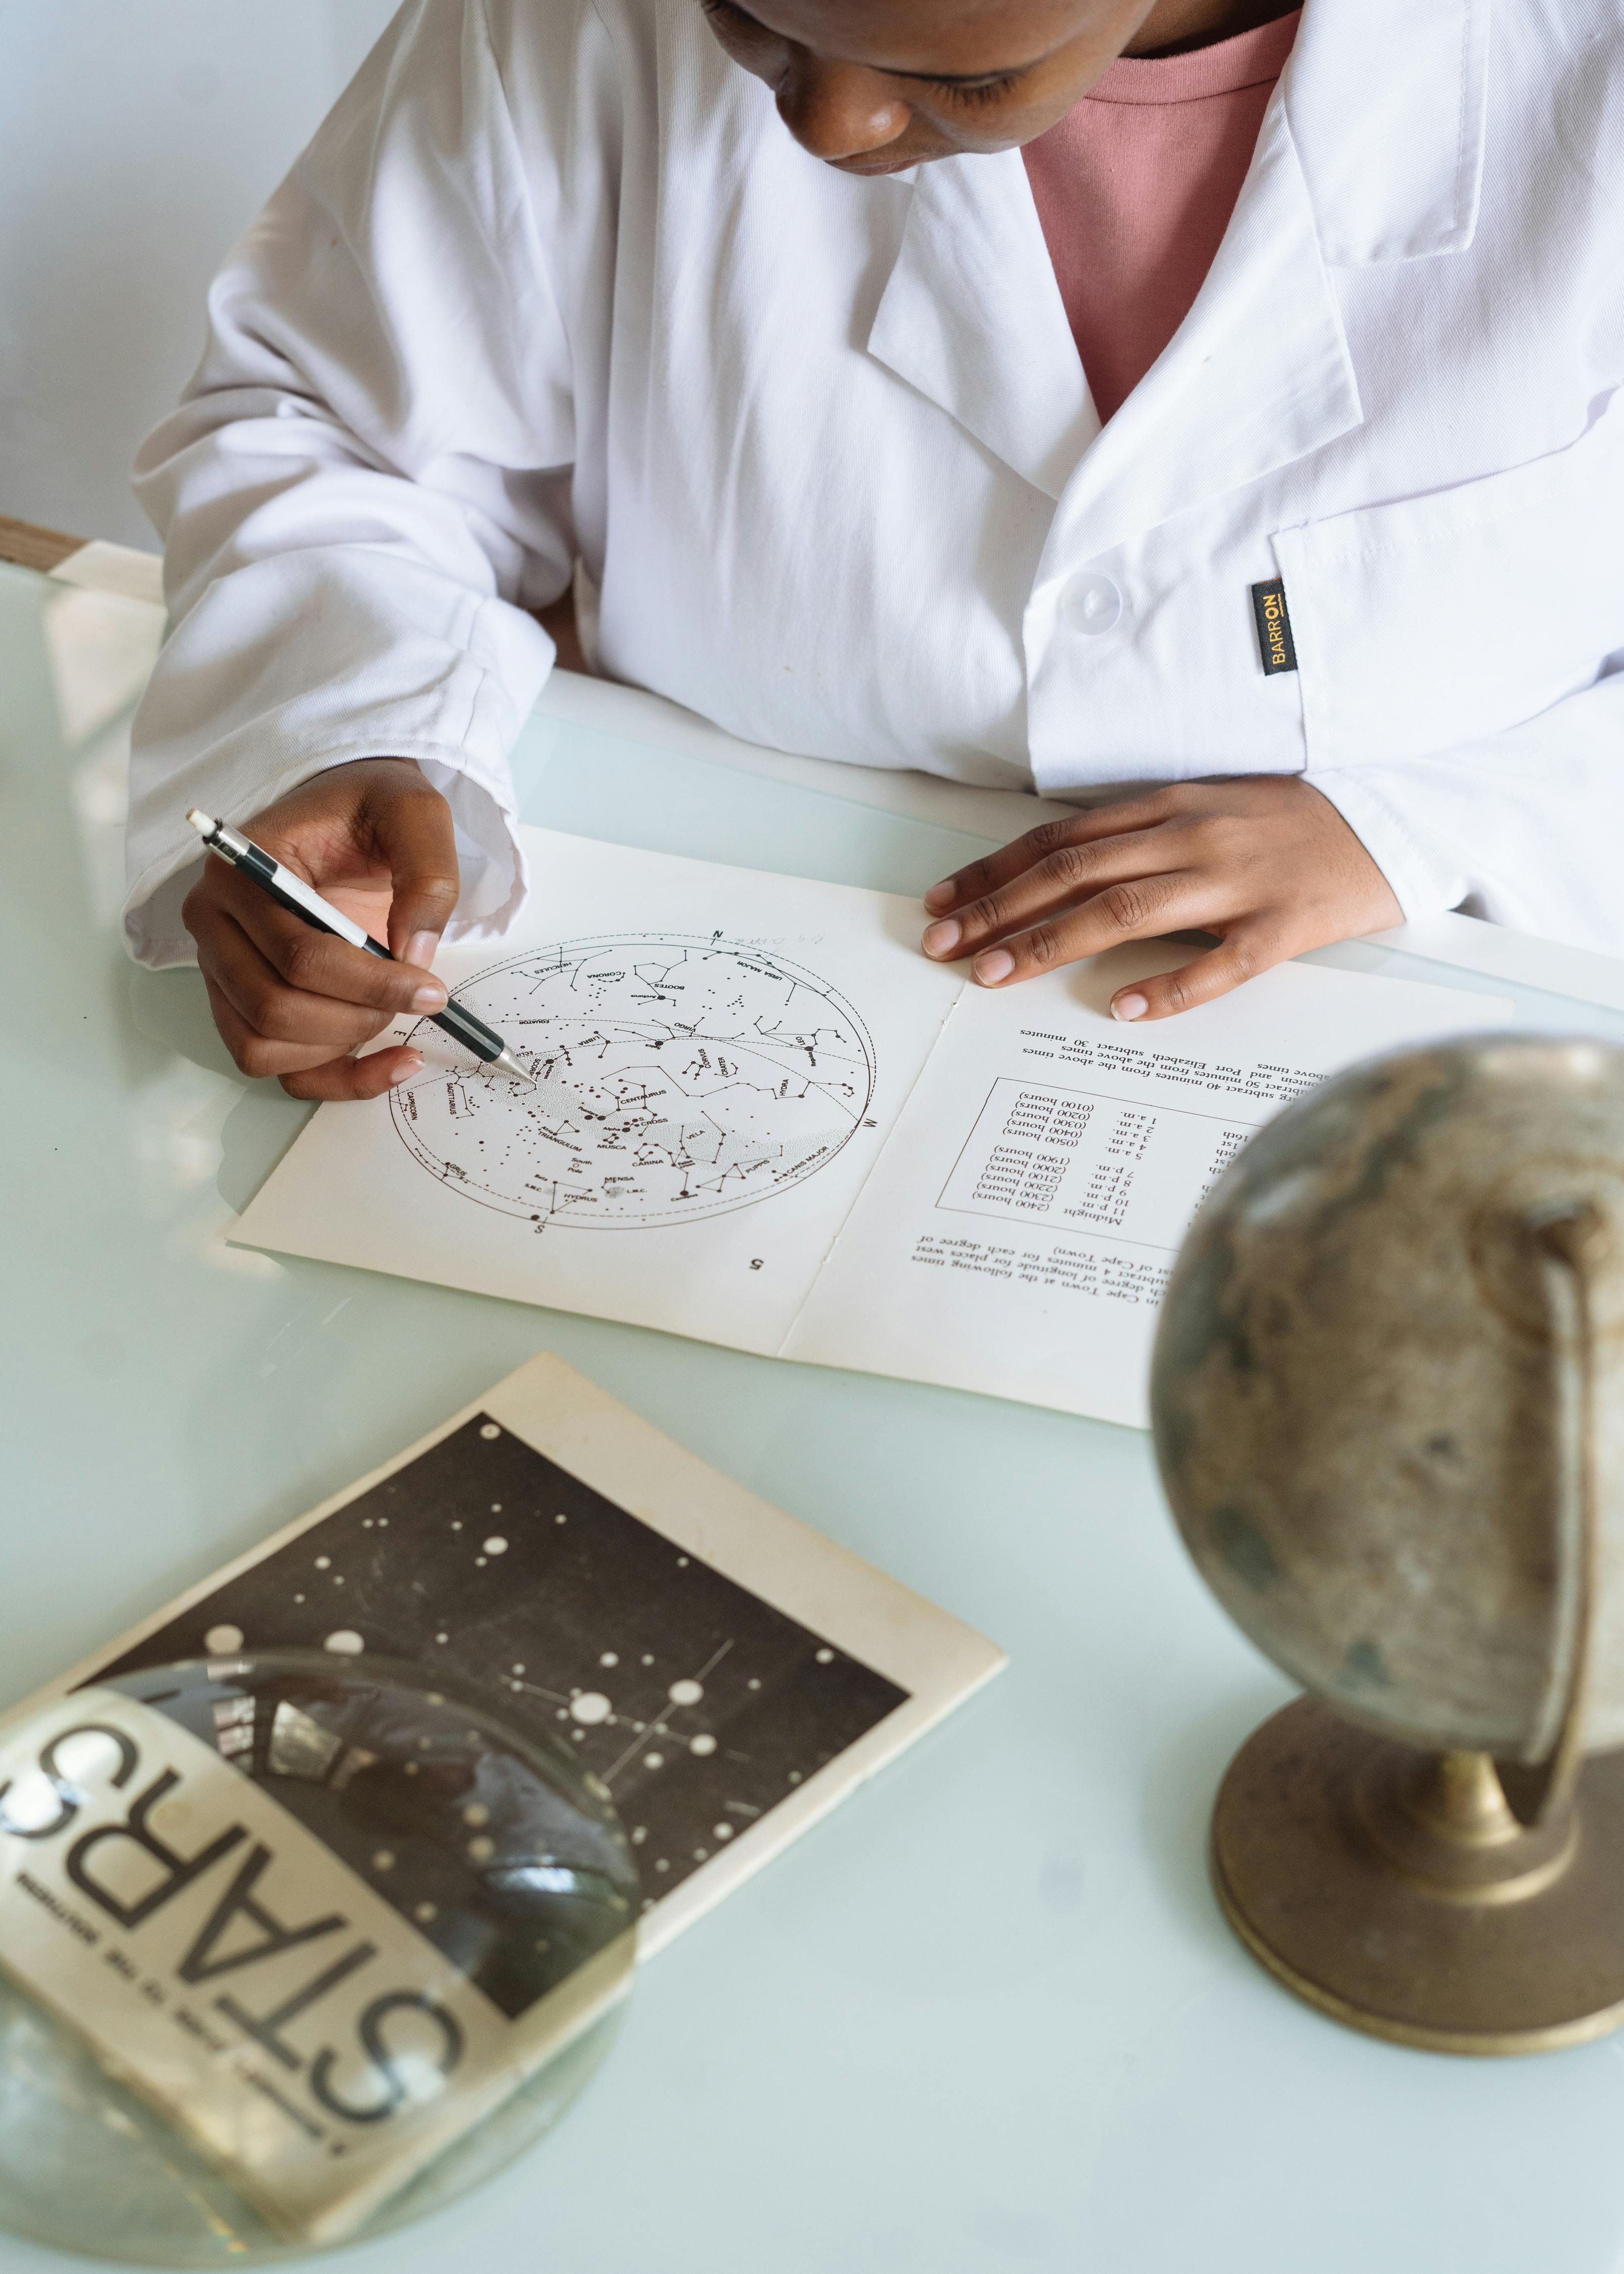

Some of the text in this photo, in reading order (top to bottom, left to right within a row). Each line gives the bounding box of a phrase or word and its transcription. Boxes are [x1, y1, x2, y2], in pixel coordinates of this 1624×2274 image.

[1263, 593, 1285, 665] BARRON
[534, 962, 572, 974] HERCULES
[736, 961, 783, 981] URSA MAJOR
[674, 1022, 696, 1032] VIRGO
[578, 1035, 600, 1046] LIBRA
[796, 1036, 805, 1046] LEO
[1020, 1030, 1066, 1041] minutes
[1023, 1049, 1054, 1058] times
[1061, 1046, 1092, 1056] times
[1096, 1044, 1144, 1056] subtract
[698, 1049, 711, 1068] CORVUS
[1059, 1055, 1093, 1065] above
[1097, 1053, 1132, 1063] above
[1137, 1060, 1155, 1068] the
[1153, 1054, 1207, 1069] Elizabeth
[718, 1057, 728, 1075] CRATER
[1098, 1062, 1116, 1070] the
[1122, 1066, 1151, 1077] from
[1160, 1064, 1189, 1075] from
[1215, 1065, 1242, 1076] Port
[1257, 1064, 1289, 1074] times
[1155, 1073, 1203, 1085] minutes
[1195, 1071, 1241, 1083] minutes
[1249, 1071, 1272, 1081] and
[780, 1079, 789, 1096] HYDRA
[1225, 1086, 1274, 1098] subtract
[1265, 1082, 1307, 1096] ubtract
[447, 1082, 457, 1115] SAGITTARIUS
[620, 1089, 667, 1104] CENTAURUS
[1020, 1092, 1058, 1106] hours)
[407, 1092, 418, 1120] CAPRICORN
[1016, 1101, 1054, 1114] hours)
[1061, 1101, 1093, 1112] (0100
[1011, 1109, 1049, 1123] hours)
[1057, 1110, 1090, 1121] (0200
[641, 1118, 668, 1126] CROSS
[862, 1118, 878, 1128] W
[1007, 1118, 1045, 1132] hours)
[1053, 1119, 1086, 1130] (0300
[686, 1130, 706, 1140] VELA
[1002, 1127, 1041, 1141] hours)
[1049, 1127, 1082, 1139] (0400
[538, 1131, 583, 1152] TRIANGULUM
[1045, 1136, 1078, 1147] (0500
[994, 1145, 1033, 1159] hours)
[787, 1146, 829, 1175] CANIS MAJOR
[989, 1154, 1029, 1168] hours)
[1037, 1154, 1070, 1166] (1900
[449, 1164, 467, 1176] GRUS
[745, 1159, 770, 1174] PUPPIS
[985, 1163, 1025, 1177] hours)
[1033, 1163, 1066, 1174] (2000
[981, 1172, 1021, 1187] hours)
[1028, 1172, 1062, 1183] (2100
[976, 1181, 1016, 1196] hours)
[1024, 1181, 1058, 1193] (2200
[564, 1194, 598, 1202] HYDRUS
[1020, 1191, 1054, 1203] (2300
[1116, 1199, 1129, 1207] 10
[972, 1191, 1123, 1226] Midnight (2400 hours)
[1114, 1208, 1125, 1216] 11
[535, 1225, 545, 1234] S
[916, 1245, 943, 1255] west
[939, 1239, 981, 1251] degree
[987, 1246, 1015, 1255] each
[912, 1255, 945, 1265] times
[951, 1251, 988, 1262] places
[1022, 1252, 1040, 1262] for
[1053, 1247, 1094, 1262] Town)
[749, 1258, 765, 1270] 5
[951, 1259, 1013, 1278] following
[993, 1258, 1012, 1267] for
[1047, 1257, 1097, 1271] minutes
[1102, 1257, 1134, 1269] Cape
[1017, 1262, 1077, 1281] longitude
[1019, 1273, 1038, 1283] the
[1062, 1282, 1098, 1296] Town
[1102, 1279, 1144, 1293] degree
[1107, 1291, 1139, 1303] Cape
[0, 1724, 464, 2124] STARS
